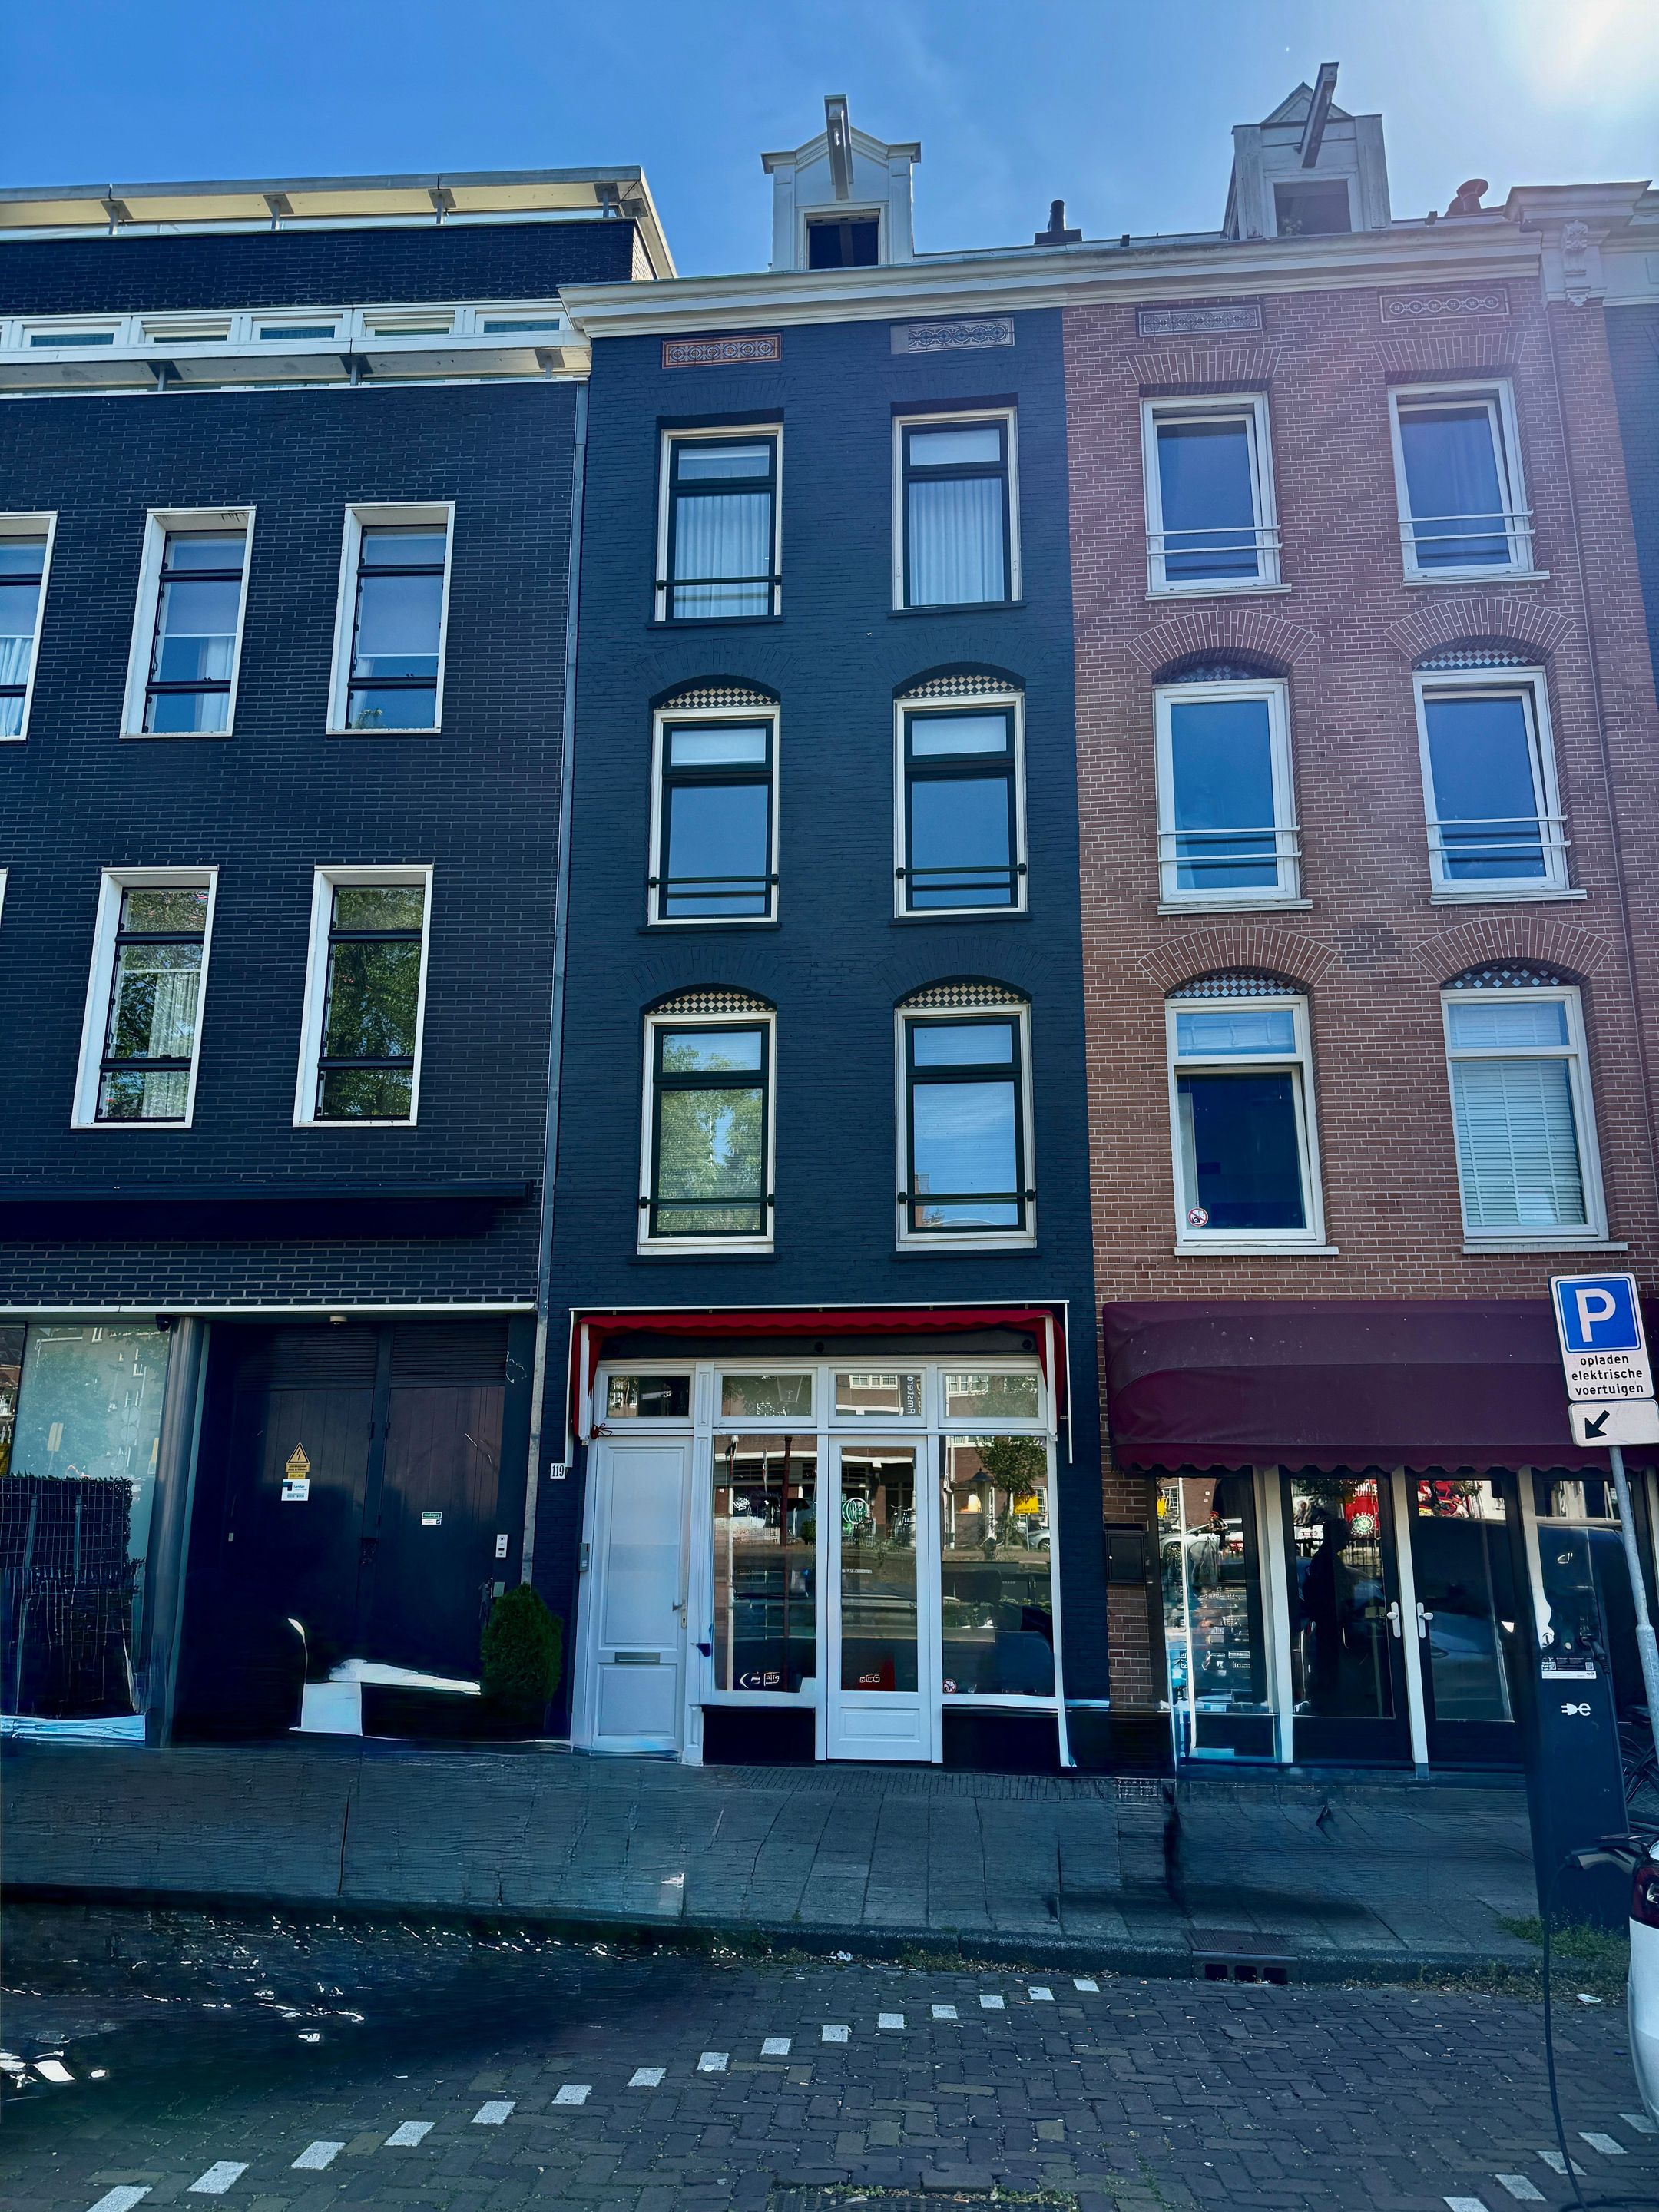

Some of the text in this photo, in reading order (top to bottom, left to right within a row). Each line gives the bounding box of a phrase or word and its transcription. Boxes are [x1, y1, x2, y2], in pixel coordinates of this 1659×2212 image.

[1575, 1288, 1616, 1343] P
[1580, 1354, 1629, 1367] opladen
[1571, 1368, 1643, 1381] elektrische
[1575, 1383, 1644, 1396] voertuigen
[552, 1465, 565, 1477] 119
